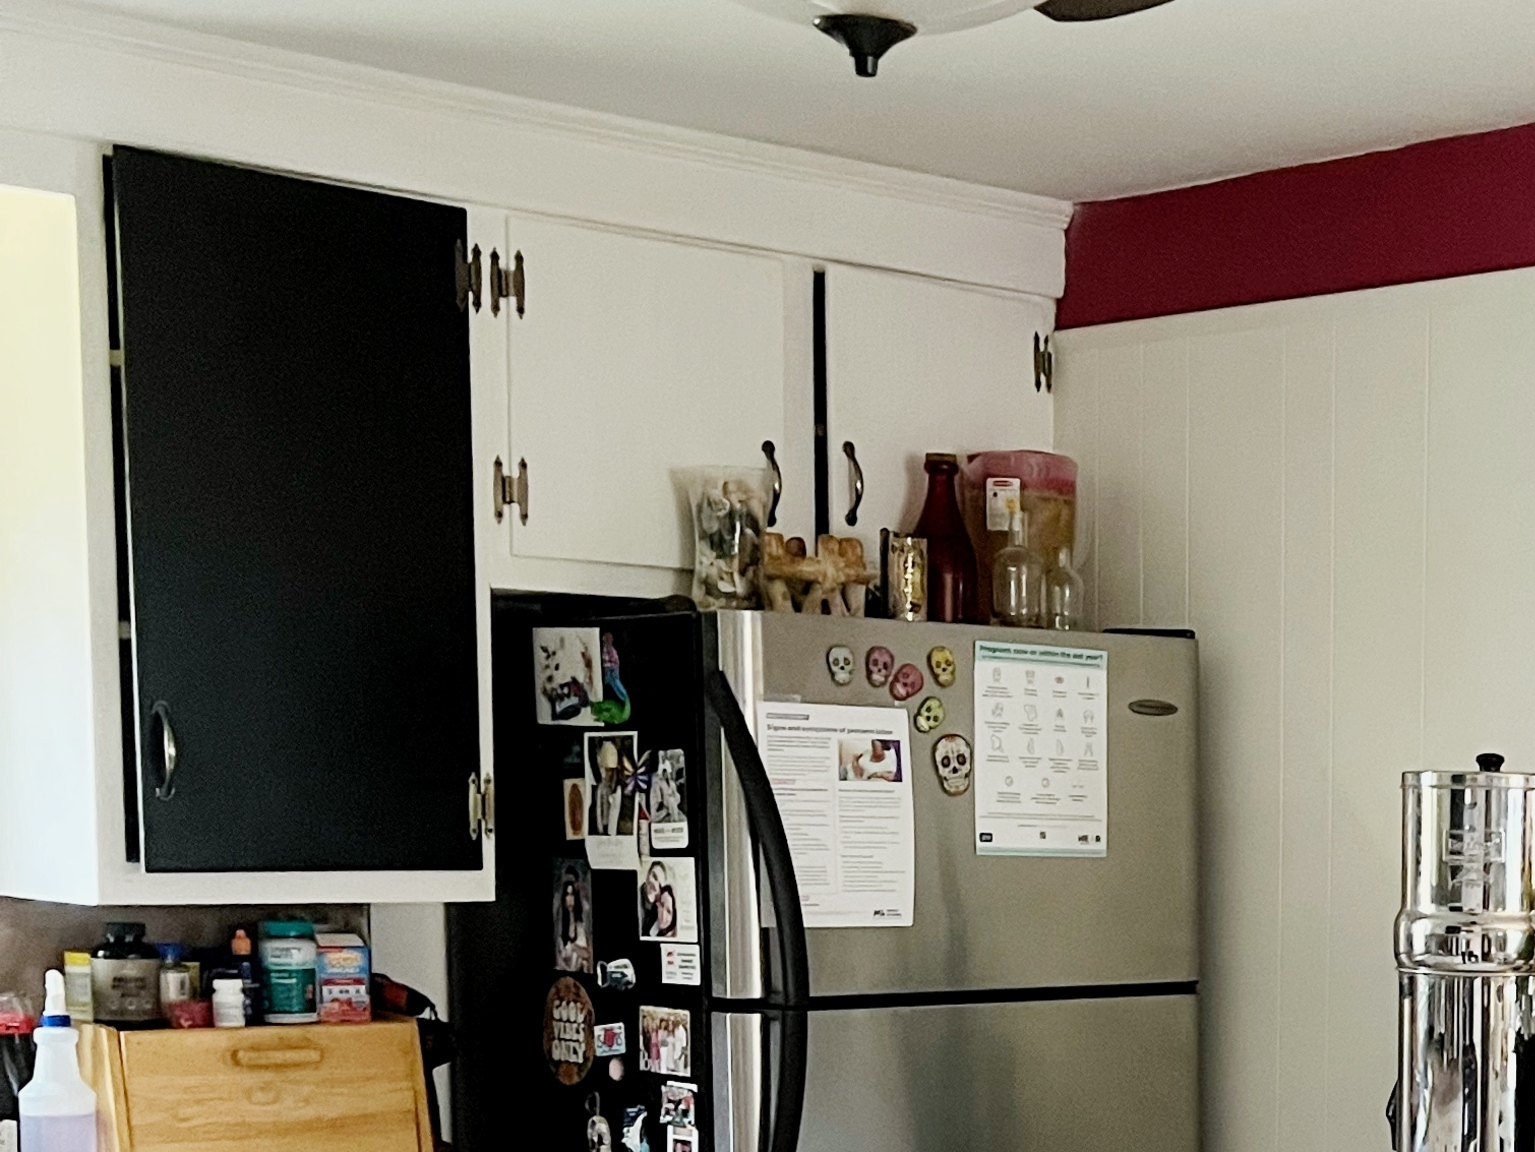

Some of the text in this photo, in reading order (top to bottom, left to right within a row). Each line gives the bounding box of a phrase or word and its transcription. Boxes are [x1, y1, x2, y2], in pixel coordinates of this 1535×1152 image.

[552, 1000, 586, 1023] GOOD
[552, 1020, 586, 1043] VIBES
[551, 1039, 586, 1064] ONLY
